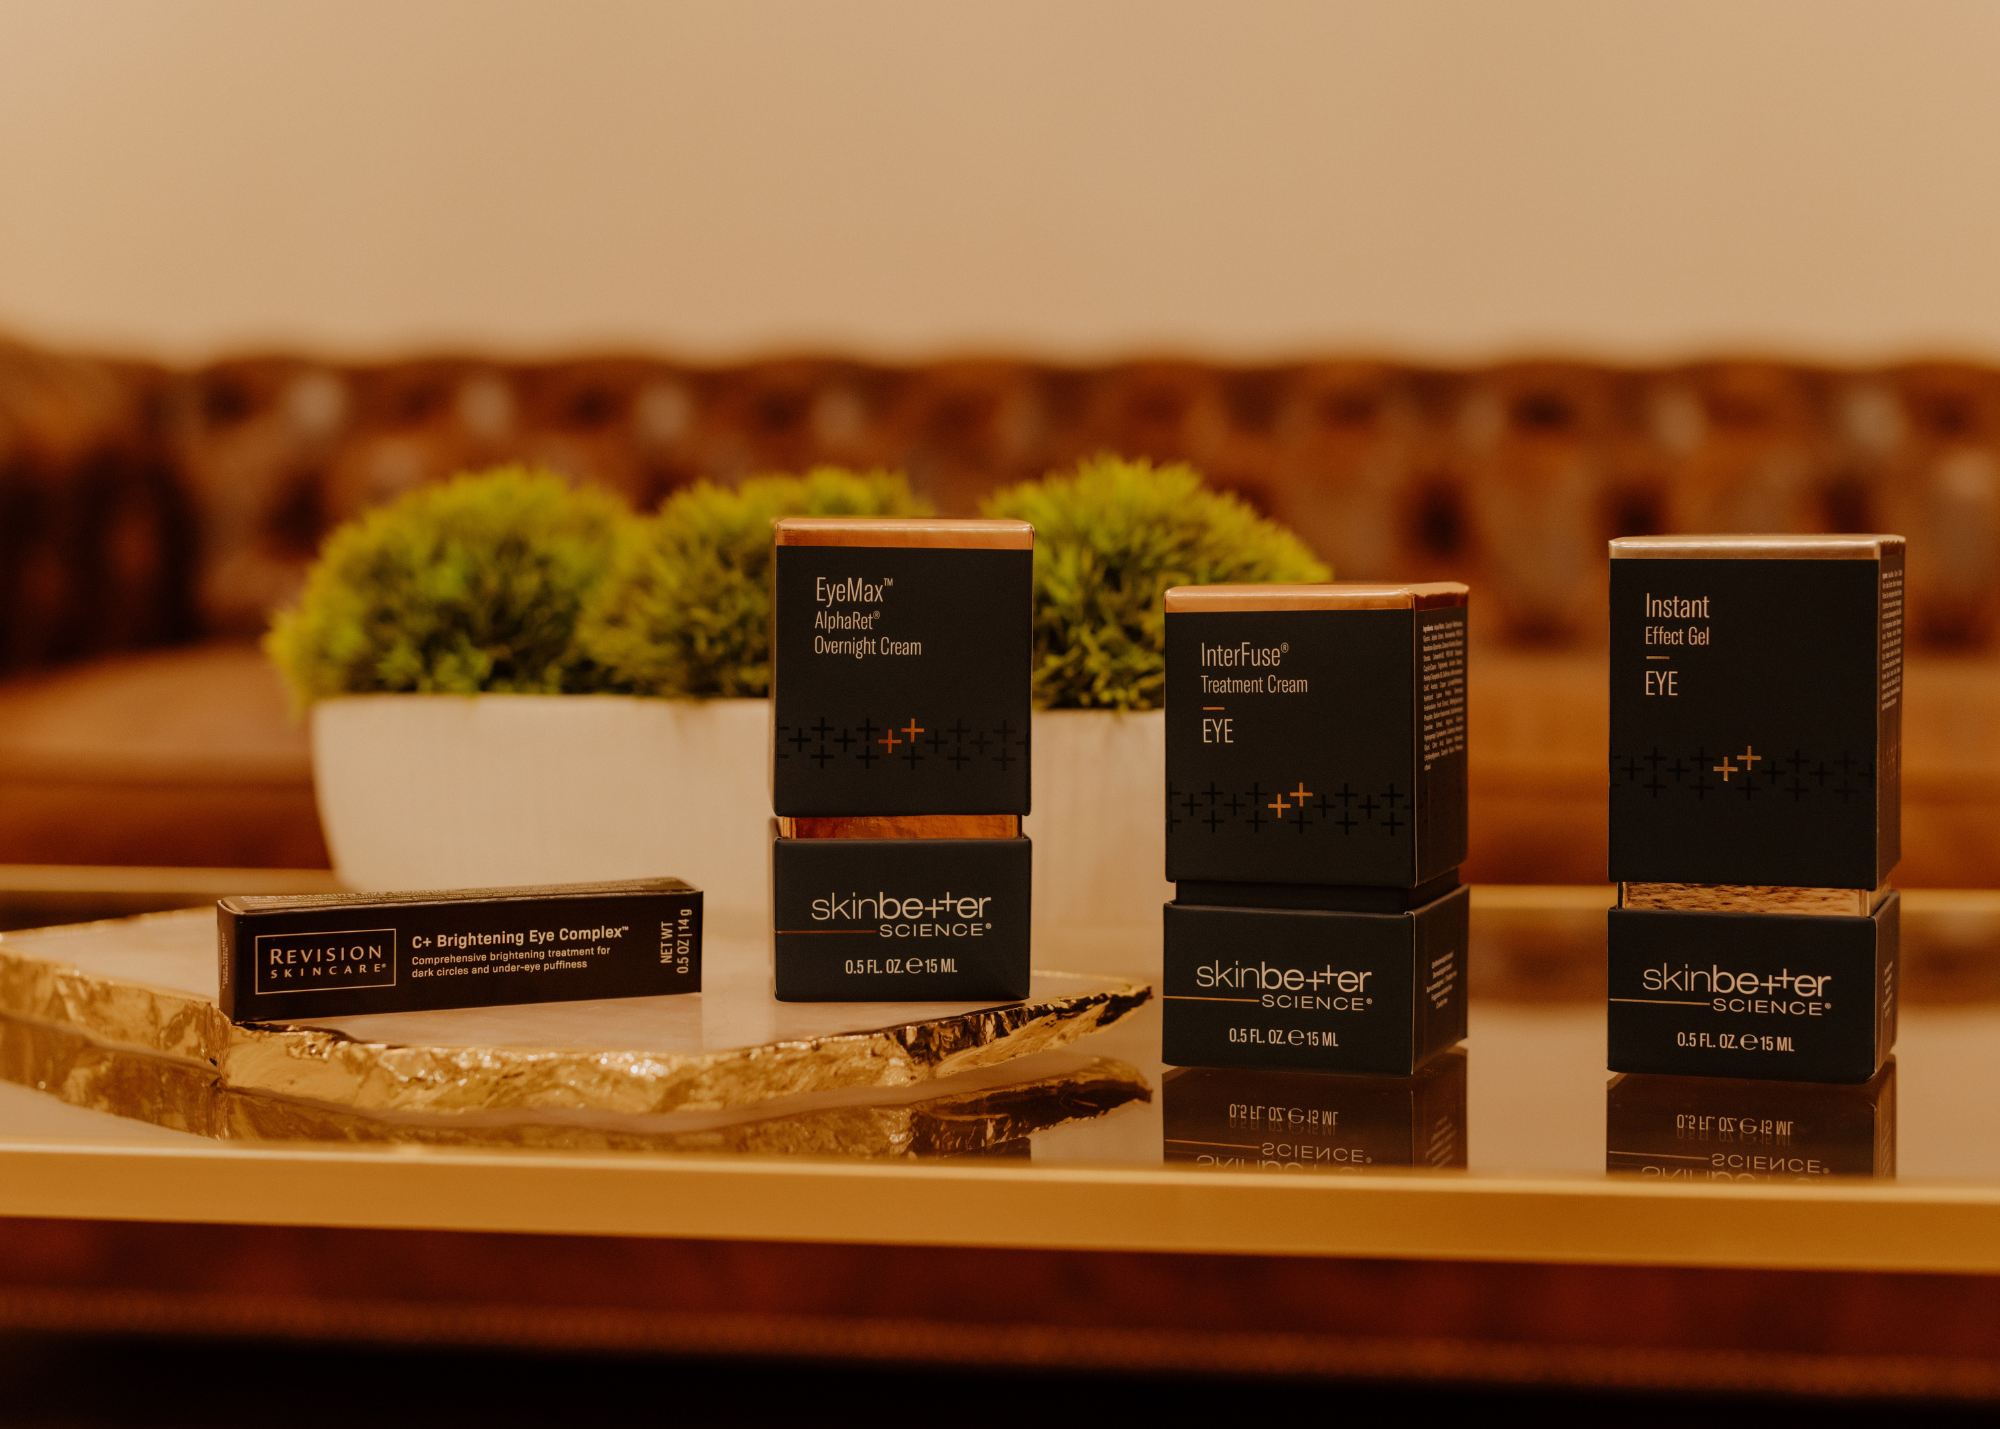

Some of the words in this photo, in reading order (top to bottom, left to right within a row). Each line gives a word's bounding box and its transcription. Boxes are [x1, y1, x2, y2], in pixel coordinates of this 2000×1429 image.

[1646, 593, 1710, 618] Instant
[1645, 626, 1684, 645] Effect
[1688, 626, 1710, 646] Gel
[815, 635, 876, 659] Overnight
[880, 637, 922, 655] Cream
[1201, 675, 1263, 693] Treatment
[1267, 674, 1308, 693] Cream
[1645, 671, 1678, 696] EYE
[1202, 718, 1234, 743] EYE
[680, 908, 693, 916] g
[660, 921, 674, 939] WT
[678, 918, 690, 931] 14
[412, 935, 432, 949] C+
[437, 931, 524, 949] Brightening
[529, 929, 555, 944] Eye
[677, 939, 690, 955] OZ
[270, 945, 382, 965] REVISION
[412, 953, 487, 966] Comprehensive
[490, 949, 545, 962] brightening
[548, 947, 595, 958] treatment
[597, 945, 611, 956] for
[660, 941, 673, 964] NET
[412, 968, 434, 978] dark
[436, 967, 469, 976] circles
[471, 965, 490, 975] and
[492, 963, 541, 973] under-eye
[543, 960, 588, 972] puffiness
[677, 957, 690, 974] 0.5
[845, 959, 864, 974] 0.5
[867, 960, 883, 974] FL.
[886, 959, 904, 974] OZ.
[925, 959, 938, 973] 15
[941, 958, 958, 973] ML
[1229, 1028, 1247, 1043] 0.5
[1250, 1029, 1265, 1044] FL.
[1268, 1030, 1286, 1045] OZ.
[1306, 1032, 1319, 1046] 15
[1322, 1032, 1339, 1047] ML
[1677, 1032, 1697, 1048] 0.5
[1700, 1033, 1716, 1048] FL.
[1719, 1034, 1738, 1049] OZ.
[1760, 1036, 1774, 1051] 15
[1777, 1037, 1795, 1052] ML
